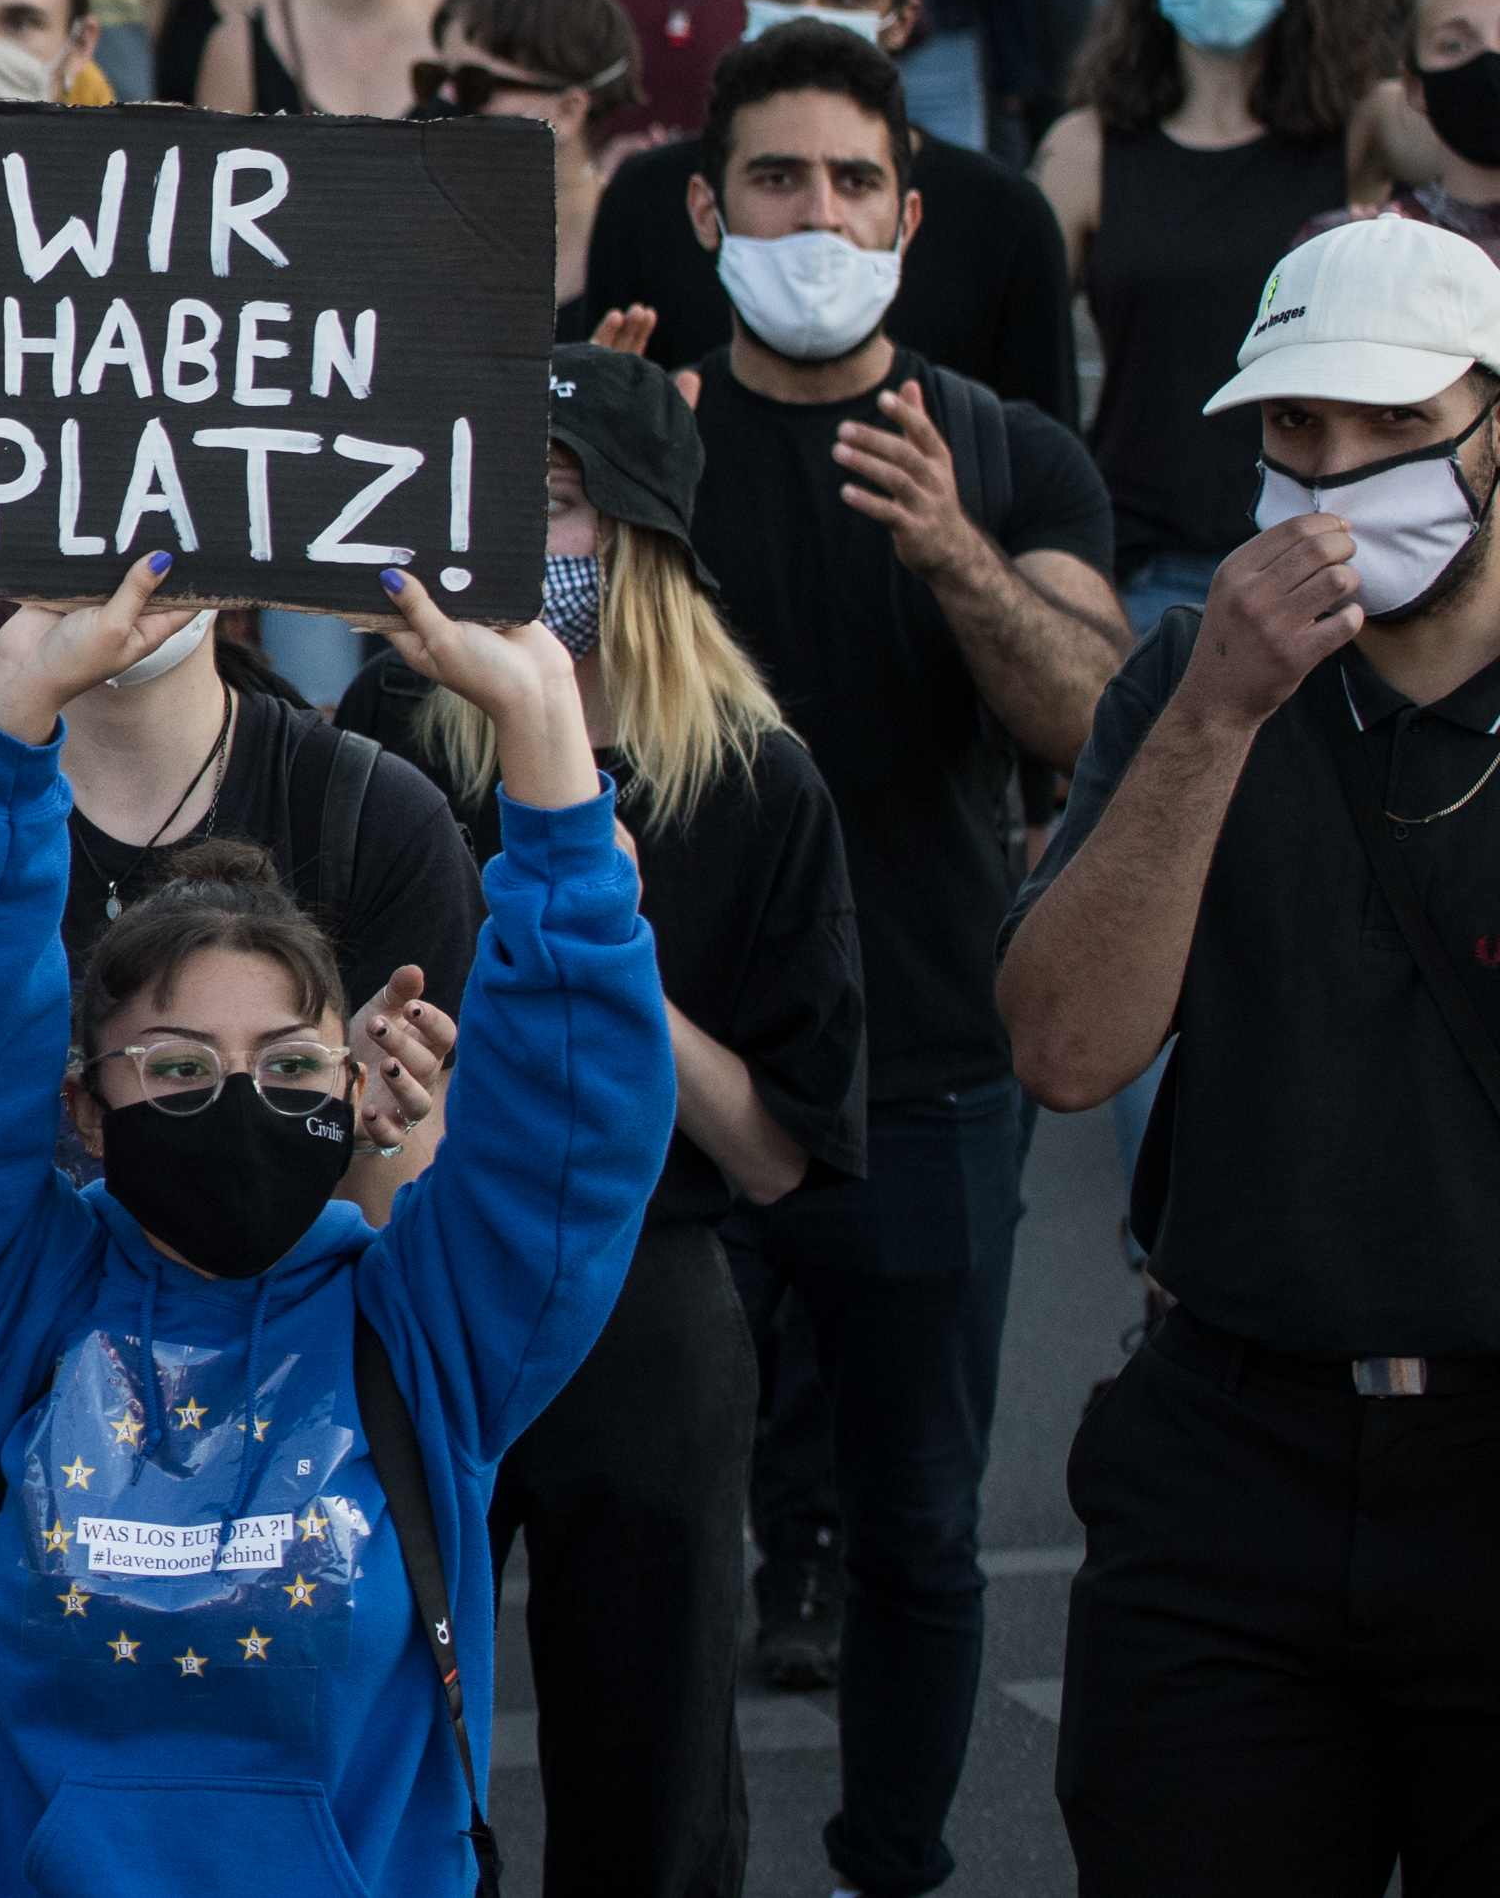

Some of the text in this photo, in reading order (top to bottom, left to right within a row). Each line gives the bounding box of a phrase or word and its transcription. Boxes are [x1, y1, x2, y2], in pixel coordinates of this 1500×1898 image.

[3, 295, 377, 407] HABEN
[83, 1522, 130, 1543] WAS
[136, 1528, 176, 1547] LOS
